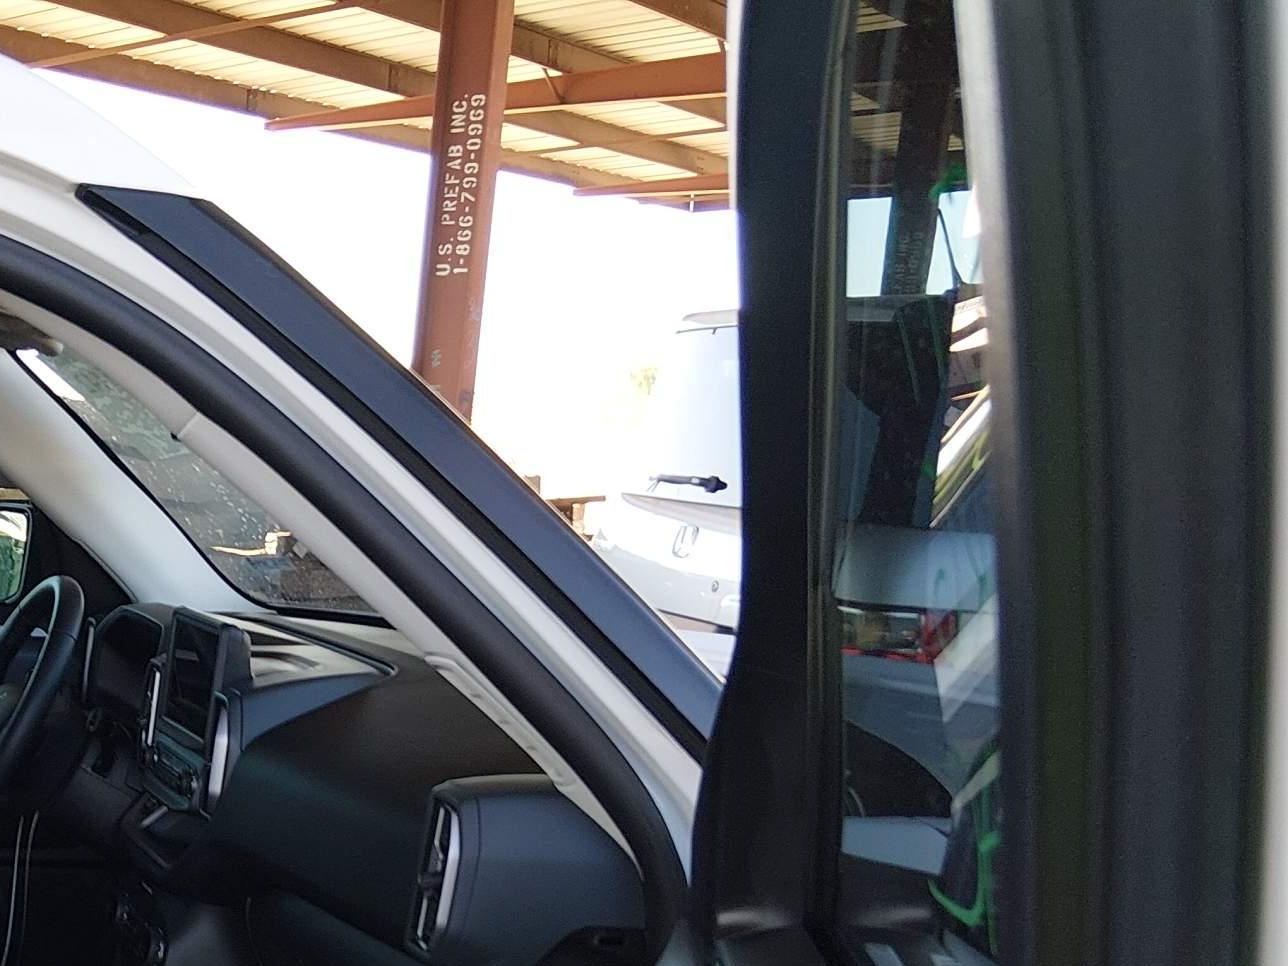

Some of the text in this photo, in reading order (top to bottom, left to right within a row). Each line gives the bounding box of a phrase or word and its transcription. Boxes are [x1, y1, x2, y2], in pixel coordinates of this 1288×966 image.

[435, 94, 469, 277] U.S. PREFAB INC.
[453, 93, 486, 274] 1-866-799-0969
